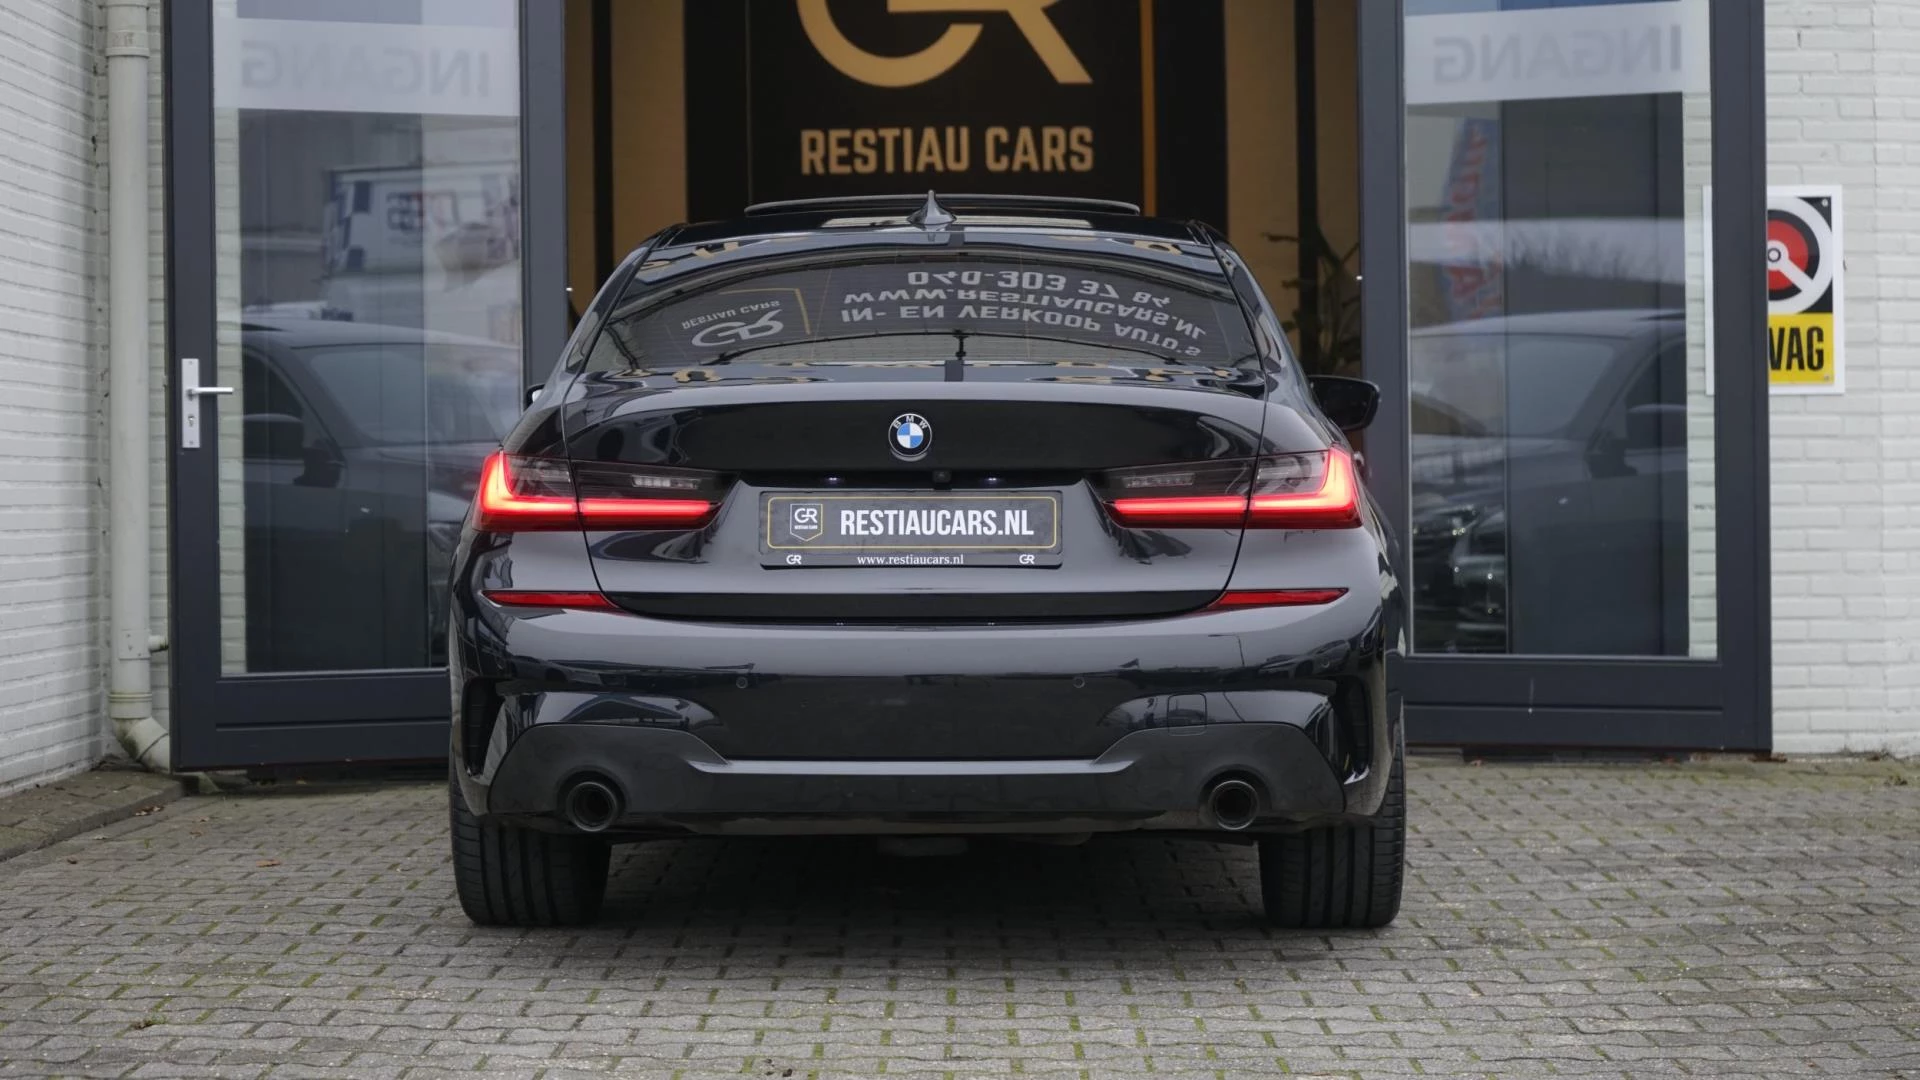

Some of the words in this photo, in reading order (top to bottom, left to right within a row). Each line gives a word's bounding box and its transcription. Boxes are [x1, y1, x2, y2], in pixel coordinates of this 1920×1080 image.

[801, 127, 970, 175] RESTIAU
[985, 126, 1093, 172] CARS
[1768, 326, 1824, 371] VAG
[893, 415, 928, 429] BMW
[840, 509, 1035, 536] RESTIAUCARS.NL
[856, 554, 964, 565] www.restiaucars.nl
